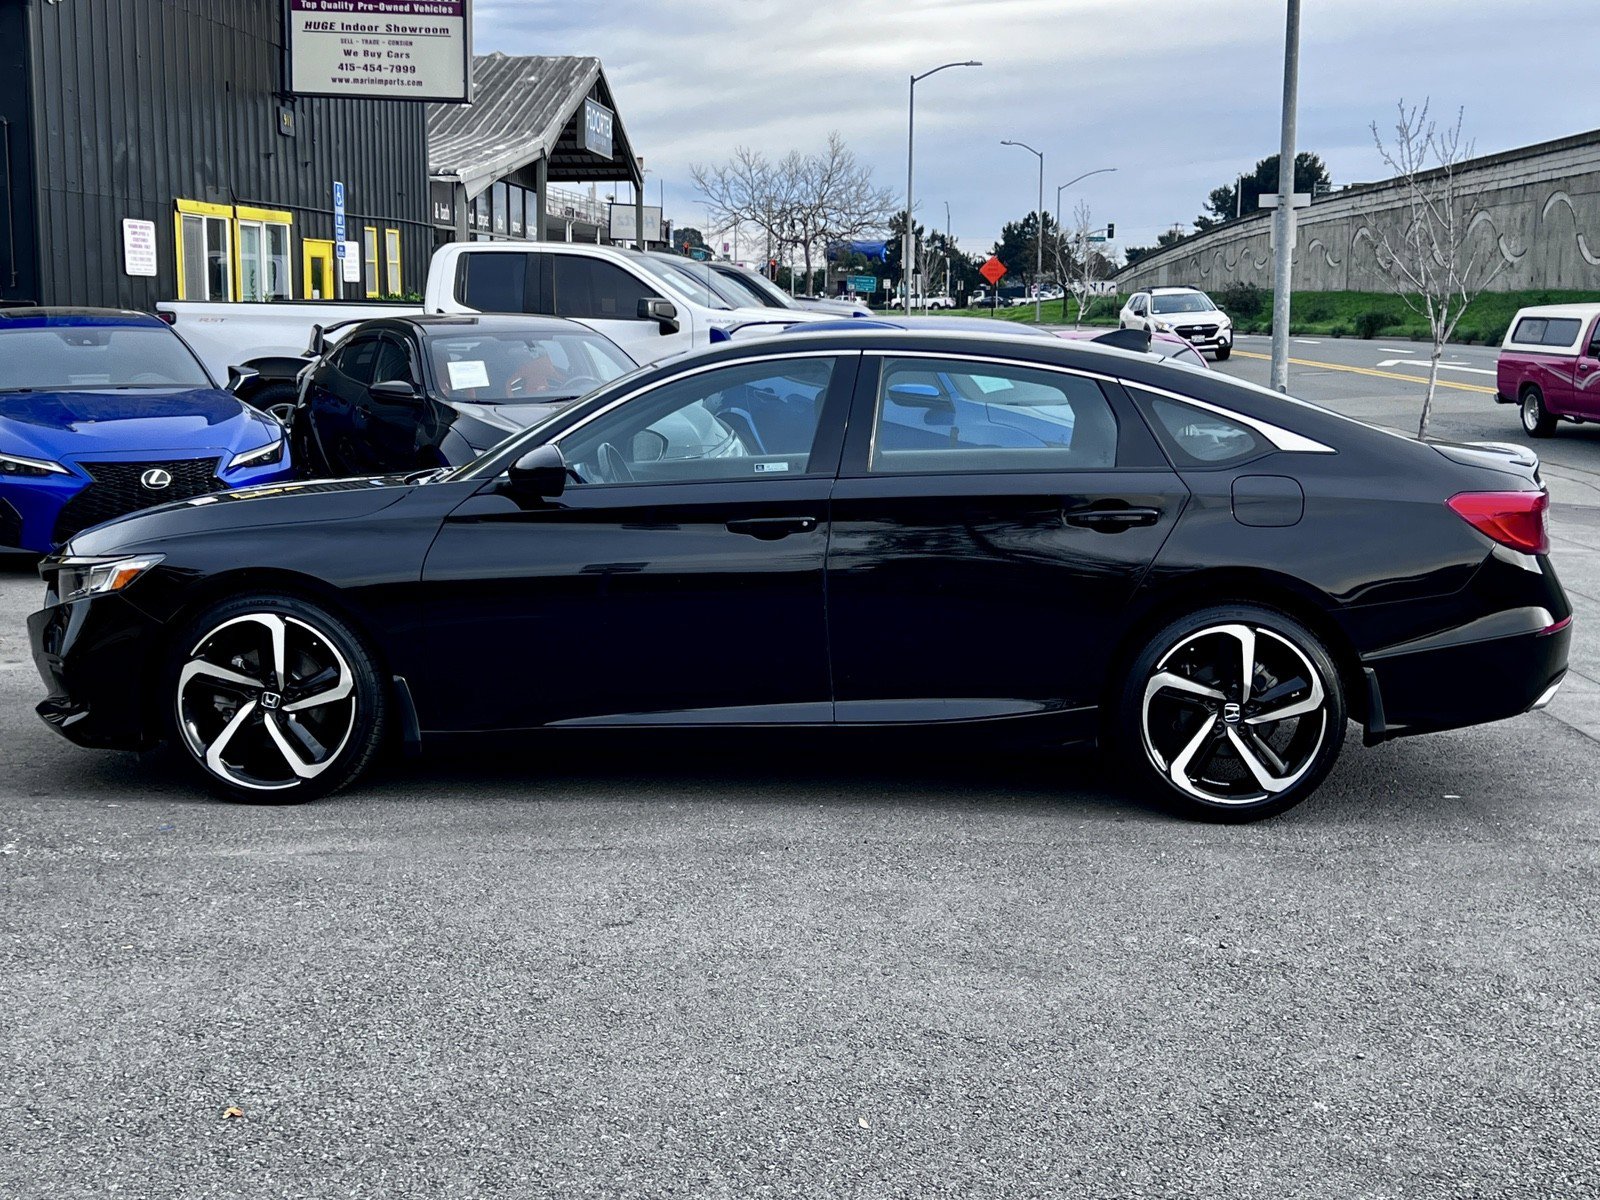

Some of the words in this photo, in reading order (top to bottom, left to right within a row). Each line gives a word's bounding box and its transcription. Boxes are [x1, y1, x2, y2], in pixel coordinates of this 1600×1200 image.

[301, 0, 319, 9] Top
[320, 1, 353, 11] Quality
[357, 2, 410, 13] Pre-Owned
[413, 4, 453, 14] Vehicles
[304, 21, 336, 31] HUGE
[341, 22, 380, 32] Indoor
[385, 24, 450, 34] Showroom
[343, 49, 359, 57] We
[363, 50, 382, 59] Buy
[387, 51, 410, 59] Cars
[337, 62, 416, 74] 415-454-7999
[331, 76, 423, 87] www.marinimports.com
